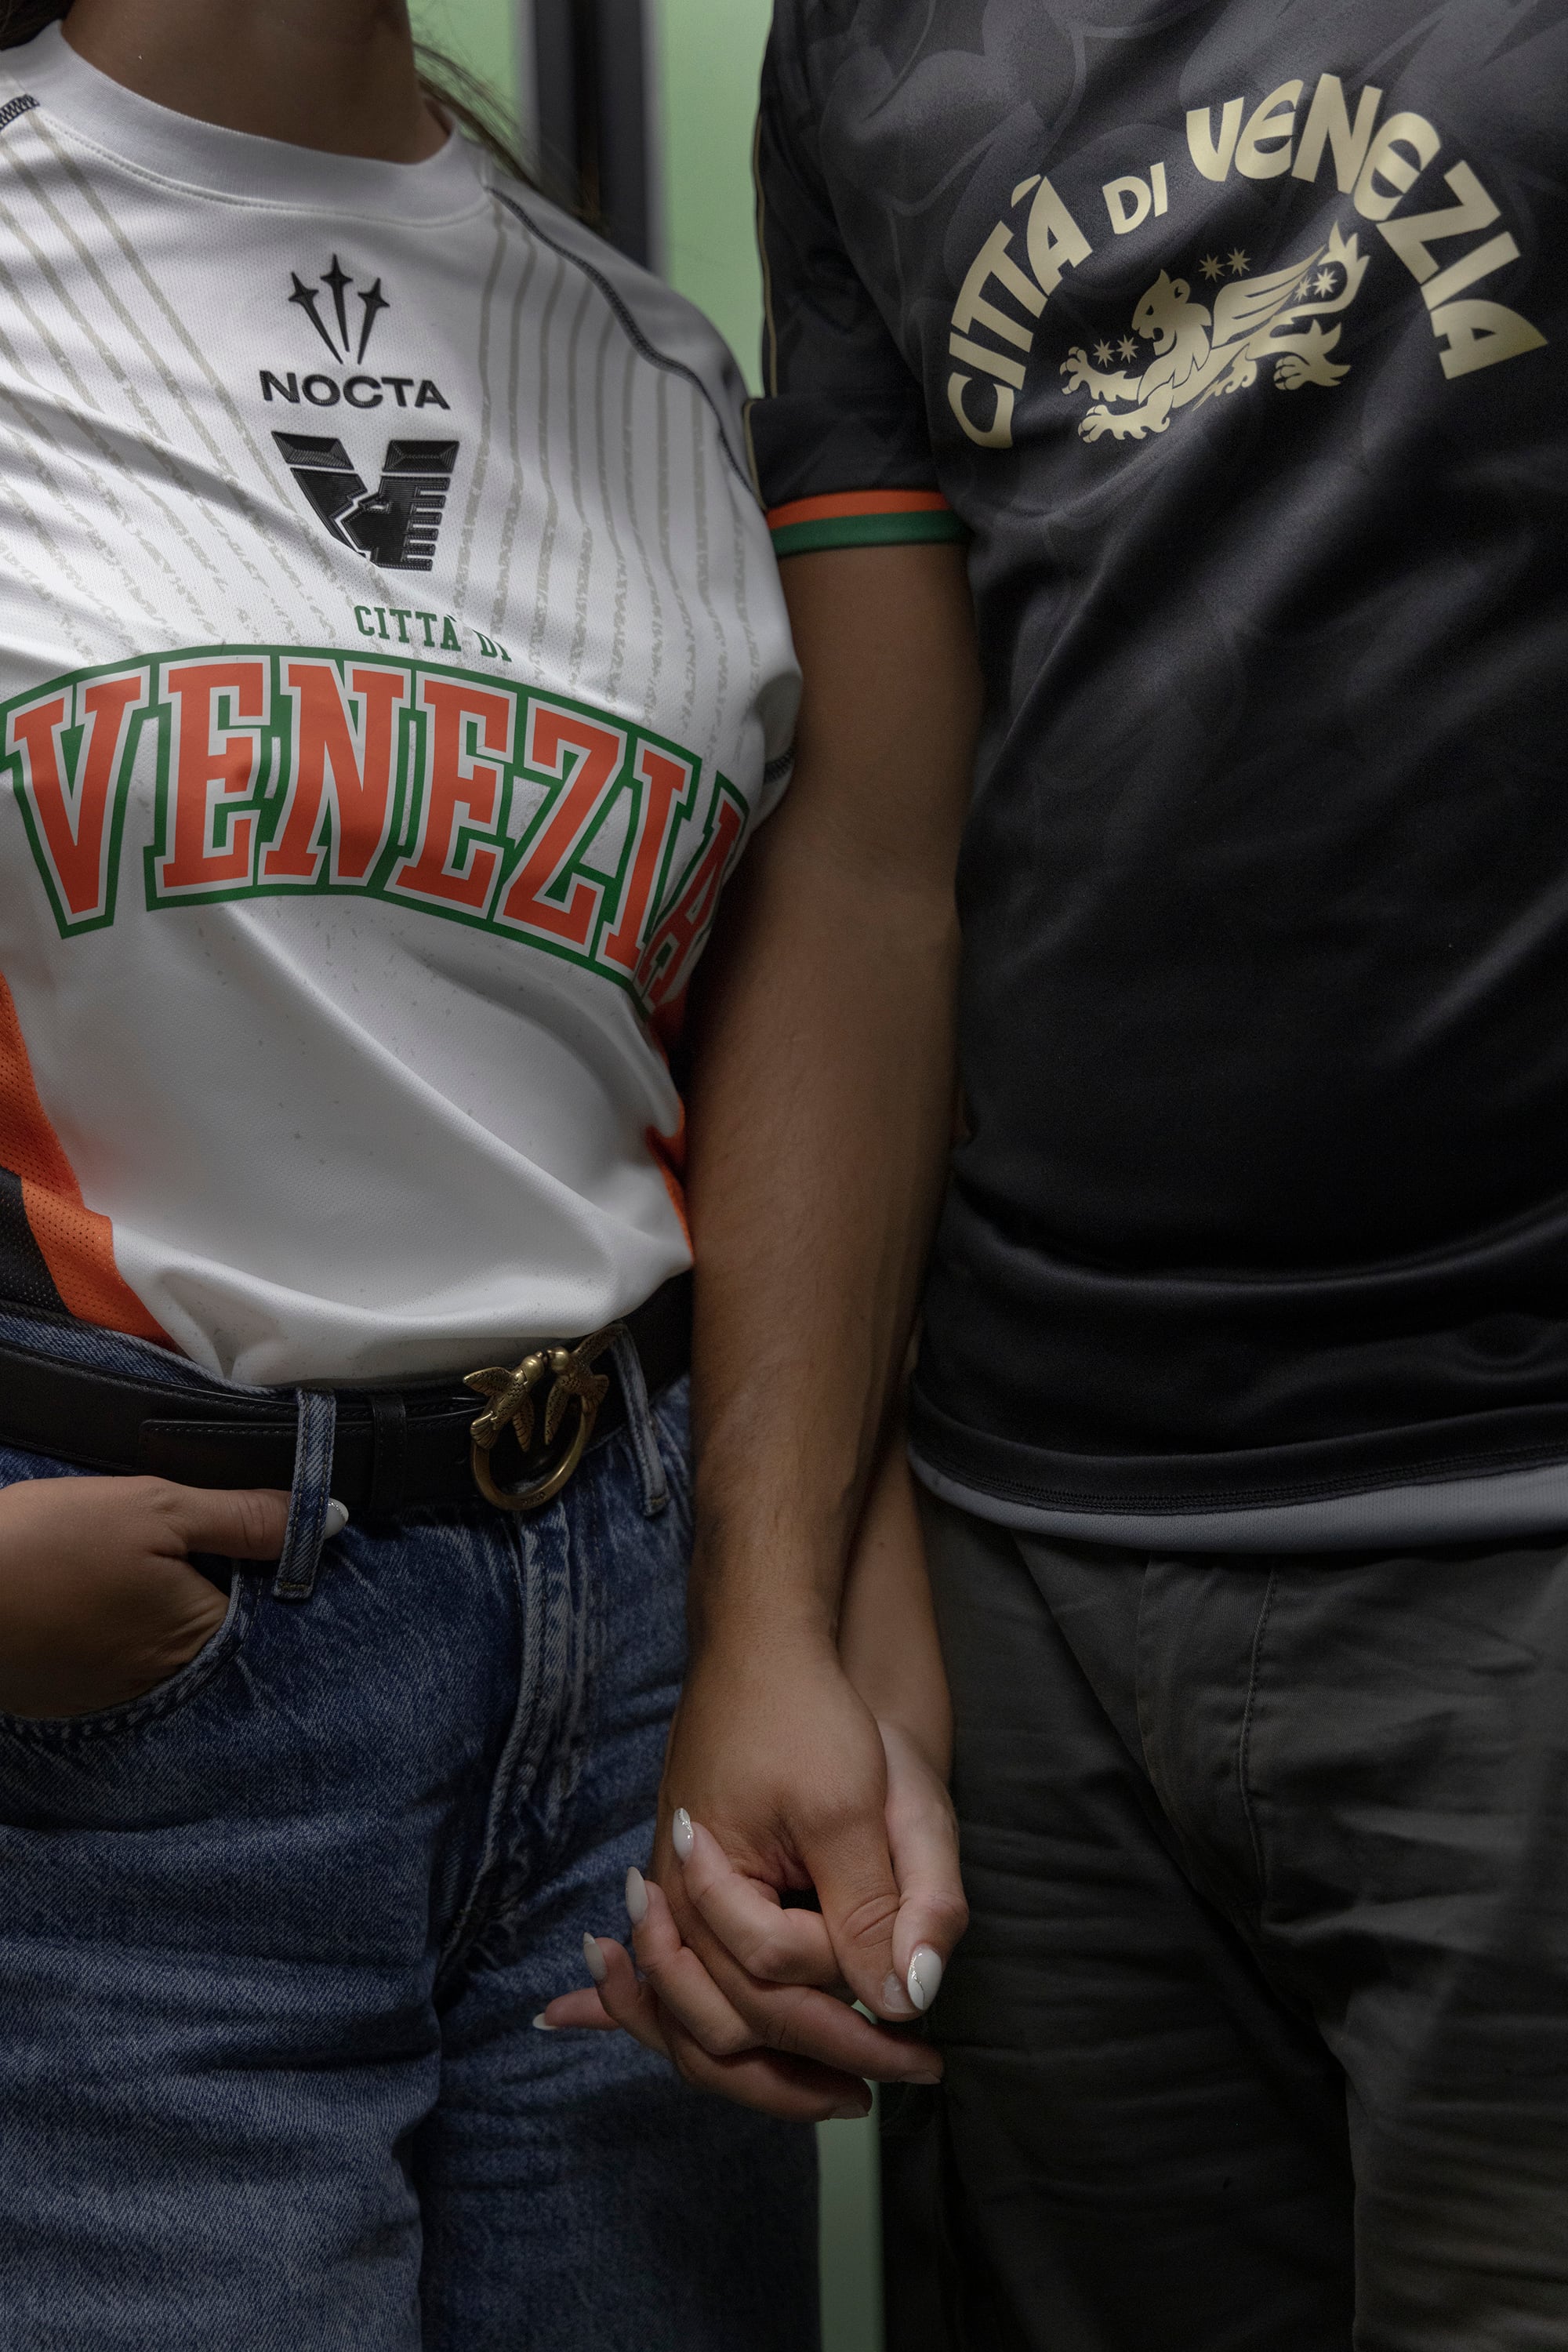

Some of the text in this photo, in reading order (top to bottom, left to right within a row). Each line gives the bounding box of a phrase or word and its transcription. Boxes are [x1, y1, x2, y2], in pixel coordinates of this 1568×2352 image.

[947, 73, 1548, 449] CITTÀ DI VENEZIA
[259, 370, 451, 410] NOCTA
[354, 605, 512, 662] CITTÀ DI
[2, 644, 750, 1017] VENEZIA
